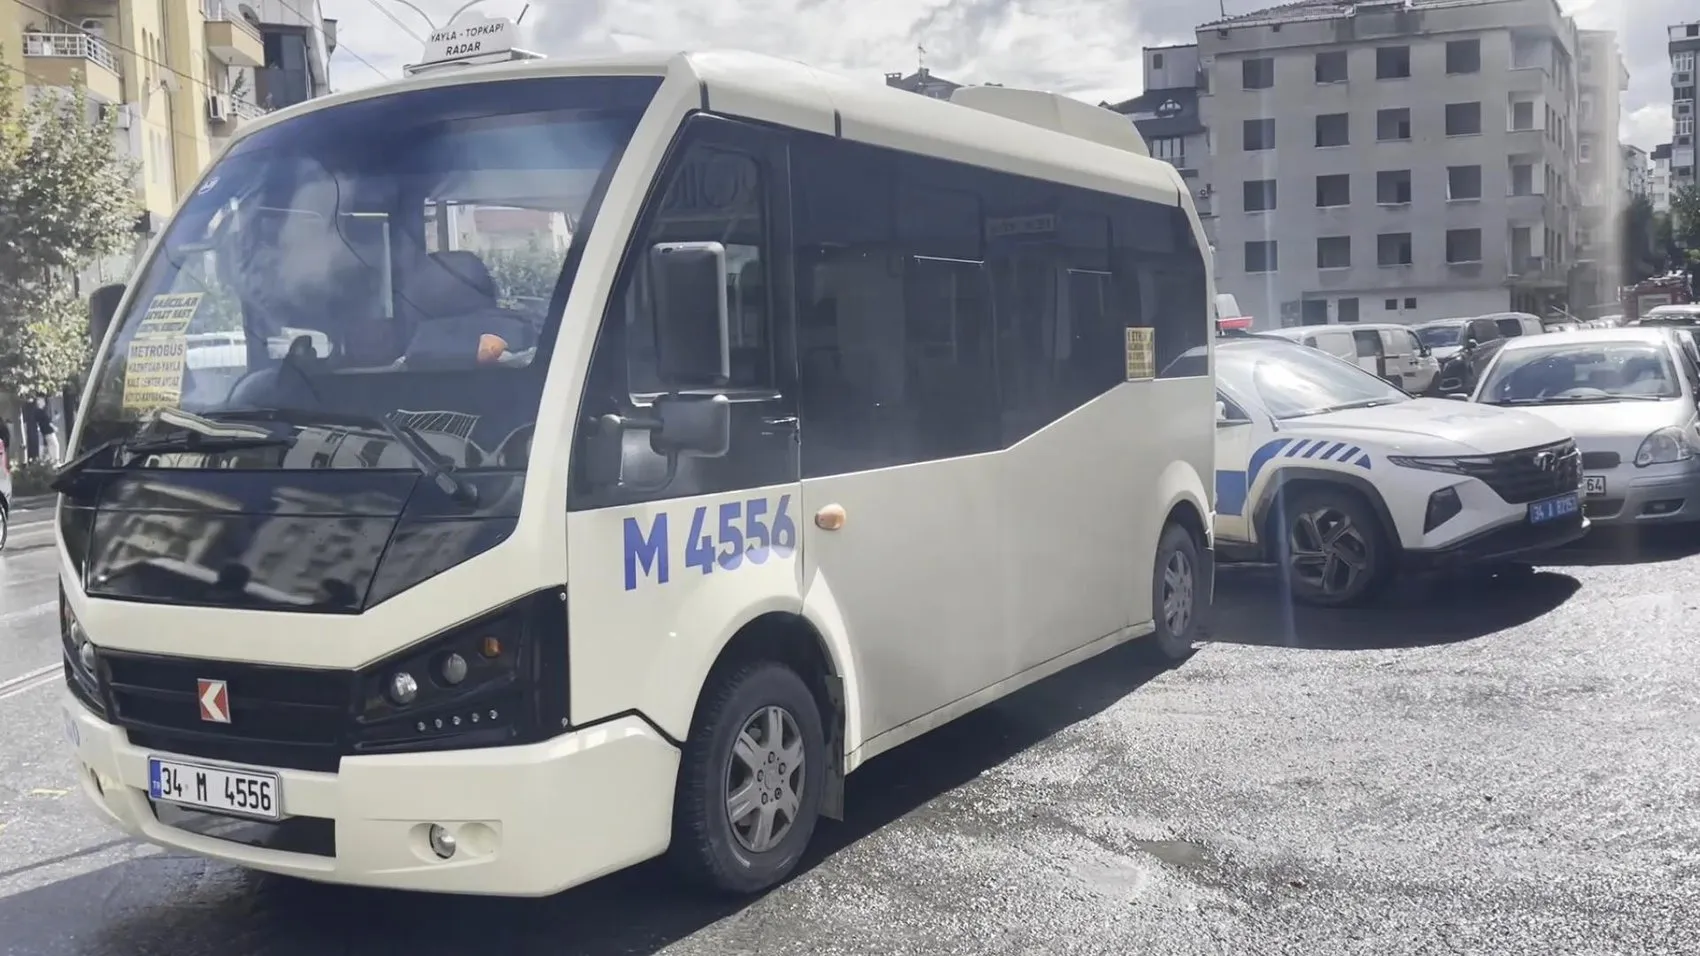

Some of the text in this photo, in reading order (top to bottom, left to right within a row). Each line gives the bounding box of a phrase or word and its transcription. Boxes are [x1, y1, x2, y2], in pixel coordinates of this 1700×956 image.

[431, 30, 457, 42] YAYLA
[466, 22, 505, 37] TOPKAPI
[445, 41, 481, 56] RADAR
[1586, 478, 1603, 492] 64
[623, 493, 796, 591] M 4556
[162, 767, 182, 797] 34
[196, 772, 208, 802] M
[225, 776, 272, 811] 4556
